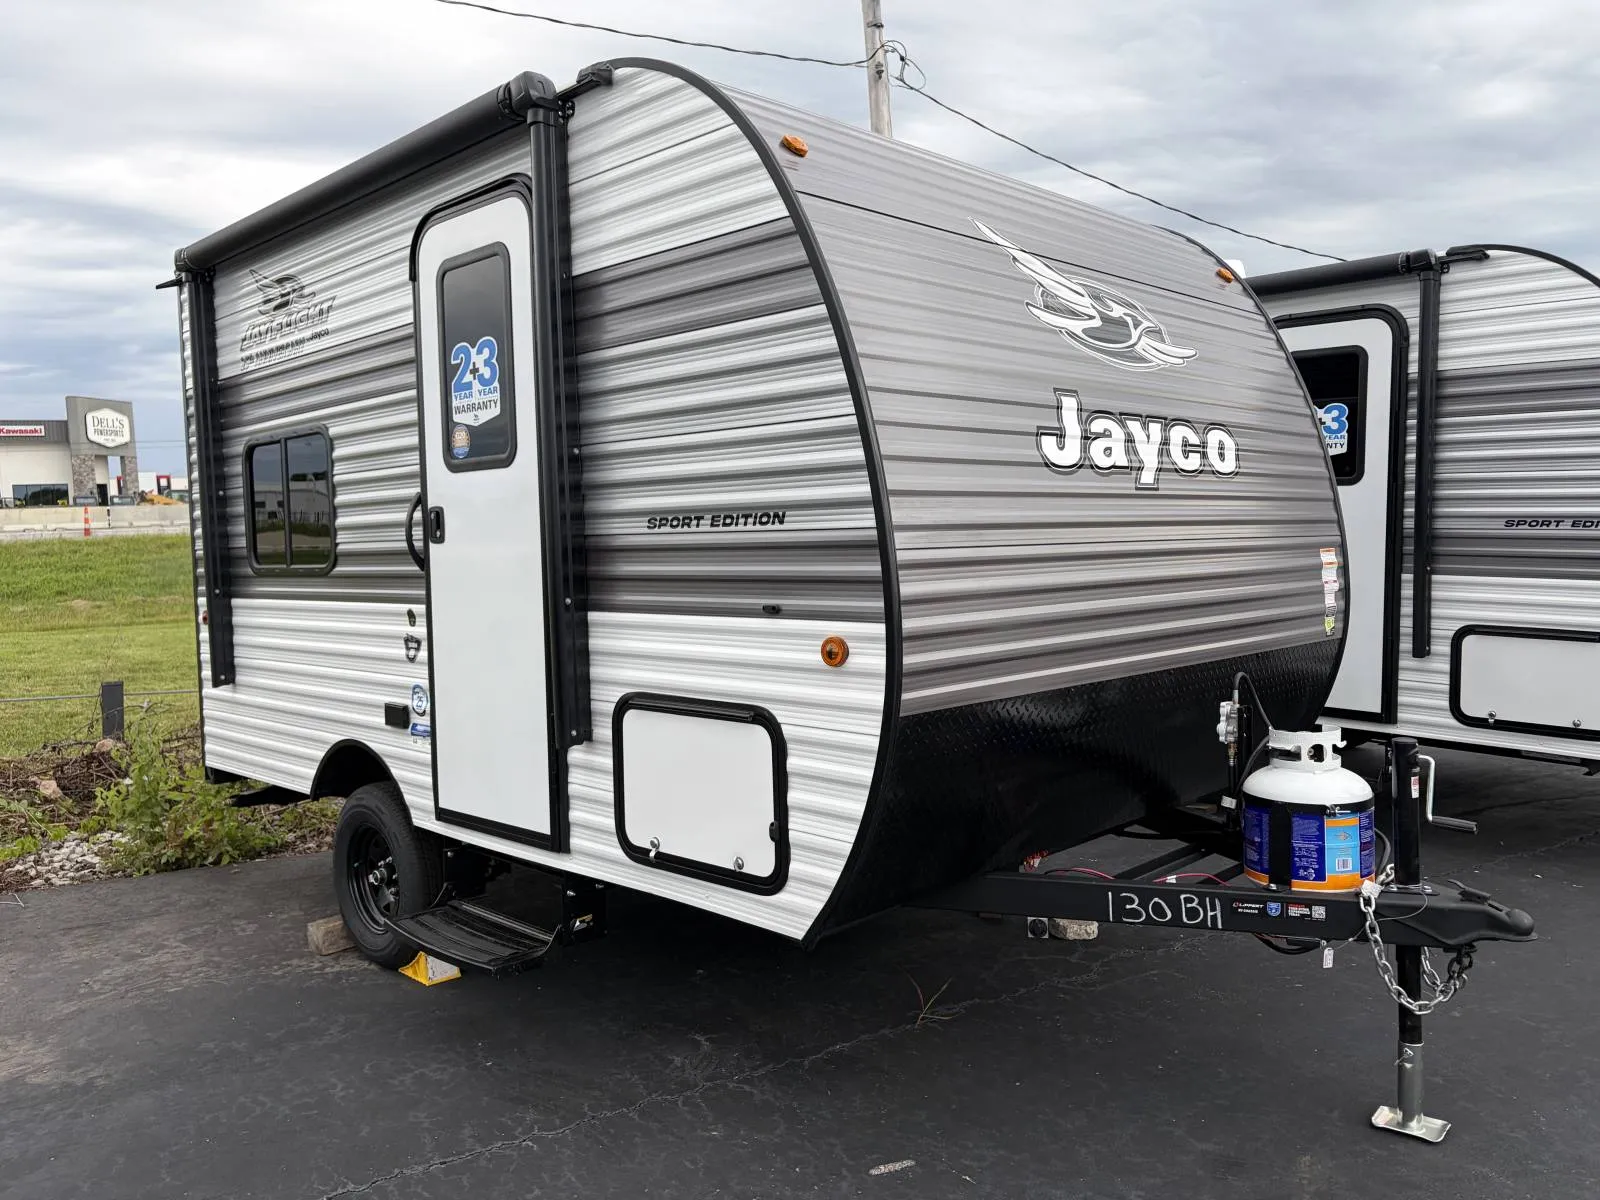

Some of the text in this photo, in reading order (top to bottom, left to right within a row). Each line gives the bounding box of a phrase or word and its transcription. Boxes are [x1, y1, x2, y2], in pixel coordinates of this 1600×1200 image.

[454, 391, 474, 401] YEAR
[477, 386, 498, 396] YEAR
[454, 399, 498, 415] WARRANTY
[92, 415, 125, 429] DELL'S
[93, 428, 125, 438] POWERSPORTS
[1036, 387, 1240, 491] Jayco
[646, 511, 787, 530] SPORT EDITION
[1503, 519, 1565, 529] SPORT
